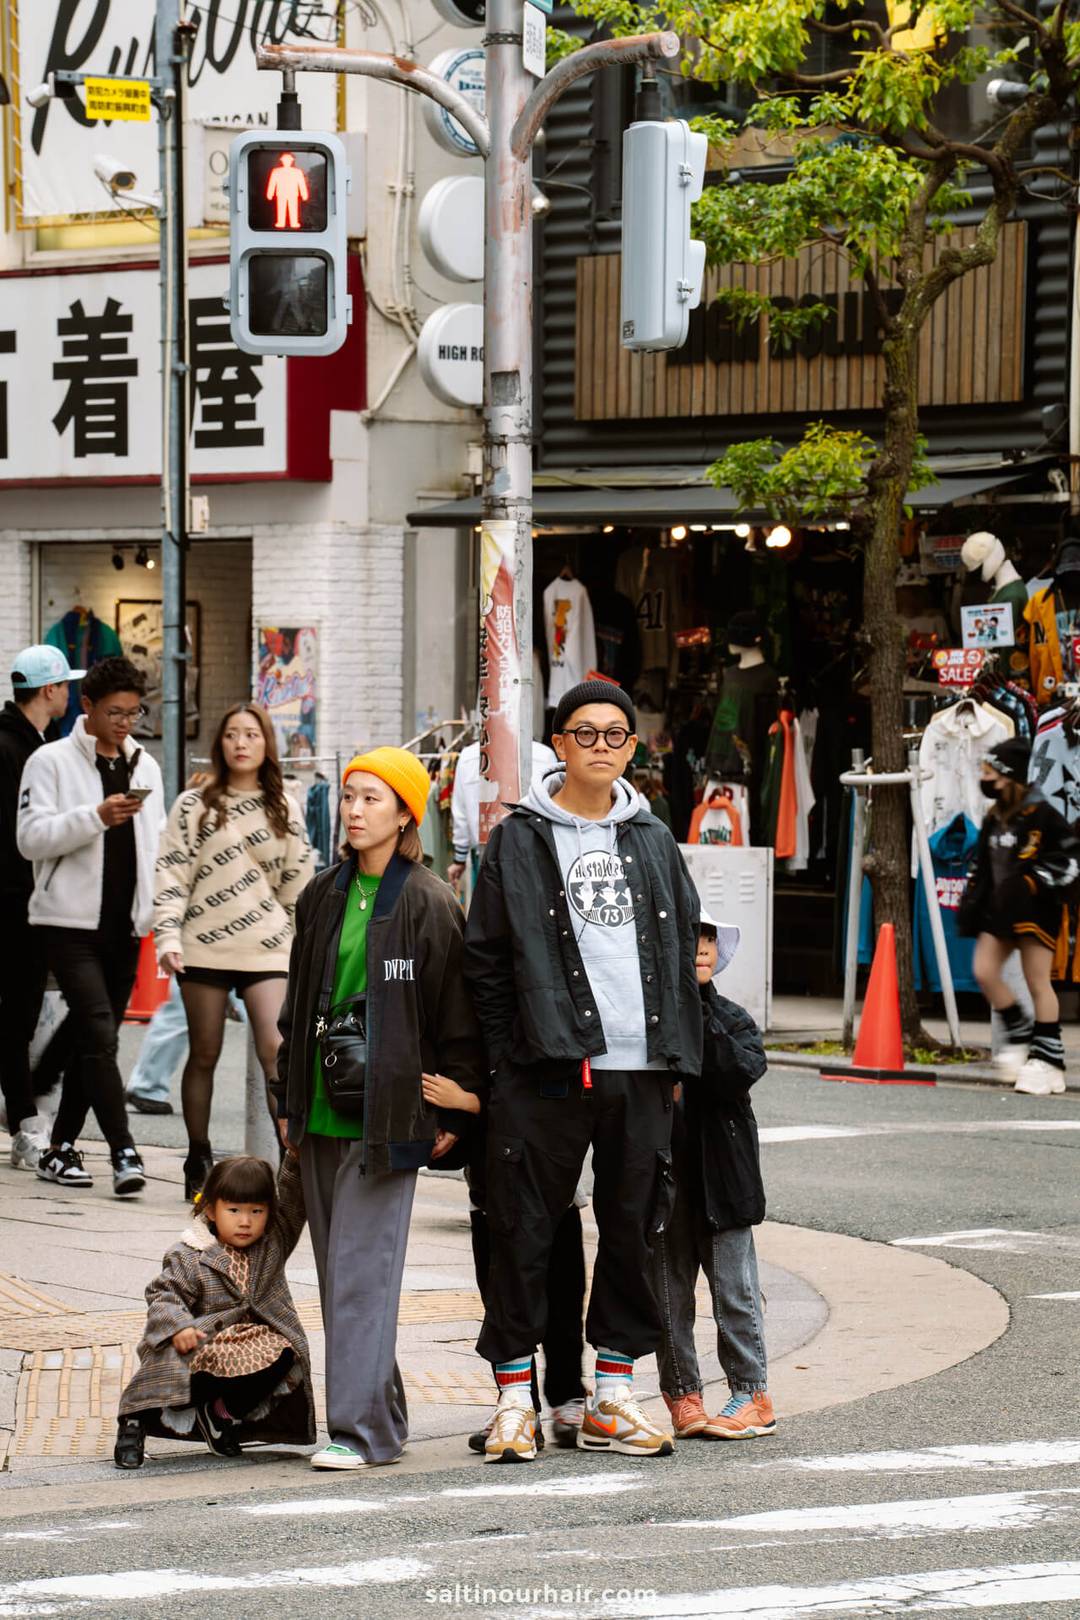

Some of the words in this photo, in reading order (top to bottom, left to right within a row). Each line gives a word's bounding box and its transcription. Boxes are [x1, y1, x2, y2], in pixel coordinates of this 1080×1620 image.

[438, 345, 467, 361] HIGH
[638, 590, 663, 630] 41
[204, 868, 263, 908] BEYOND
[196, 909, 264, 945] BEYOND
